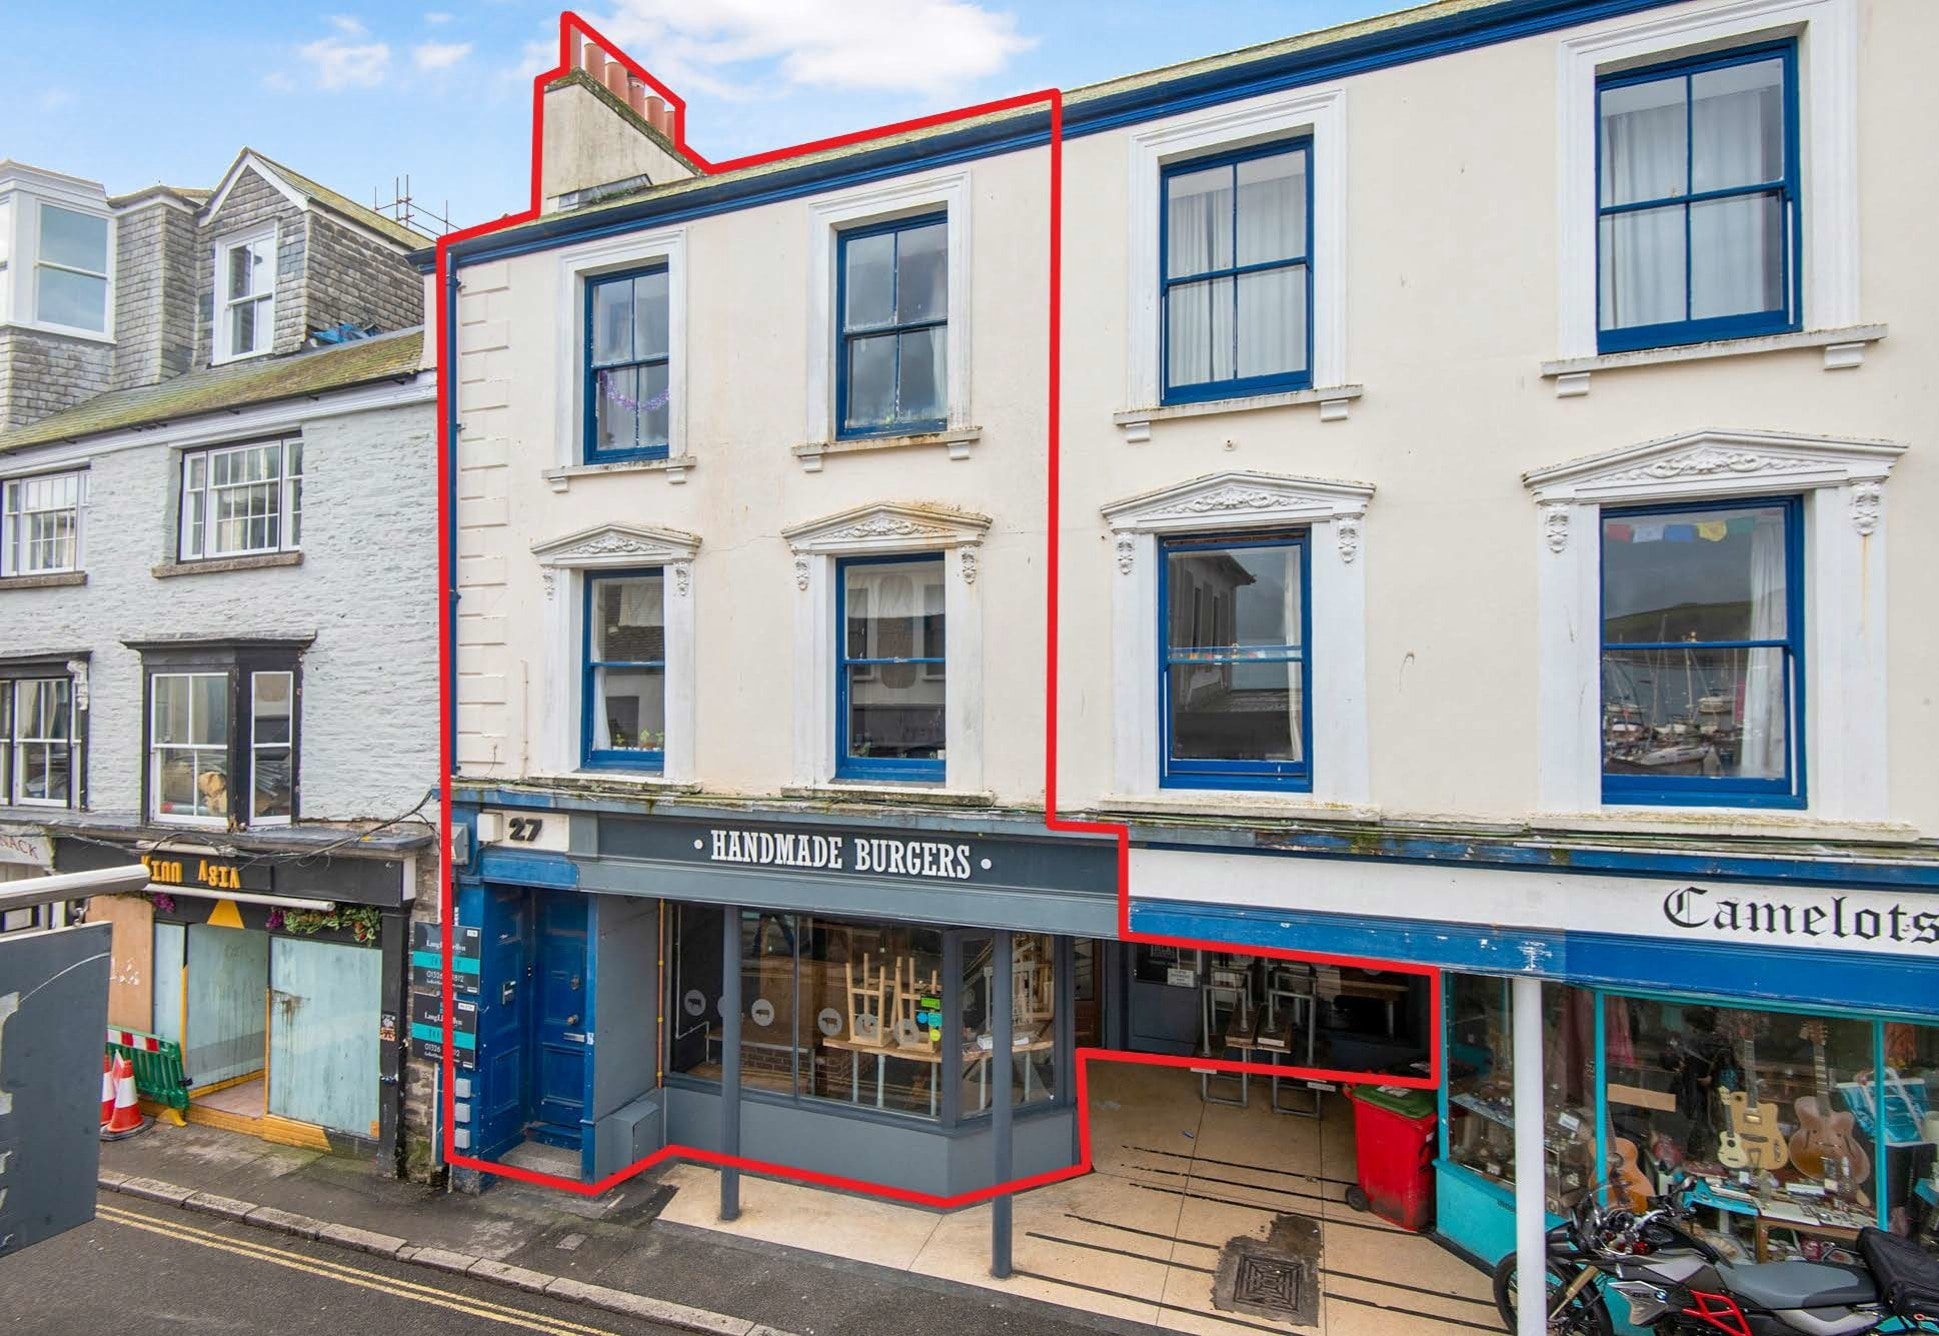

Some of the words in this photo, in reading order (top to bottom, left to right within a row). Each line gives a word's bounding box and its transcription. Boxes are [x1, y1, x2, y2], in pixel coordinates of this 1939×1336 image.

[509, 817, 543, 841] 27
[711, 829, 842, 869] HANDMADE
[854, 838, 972, 880] BURGERS
[1663, 886, 1939, 943] Camelots
